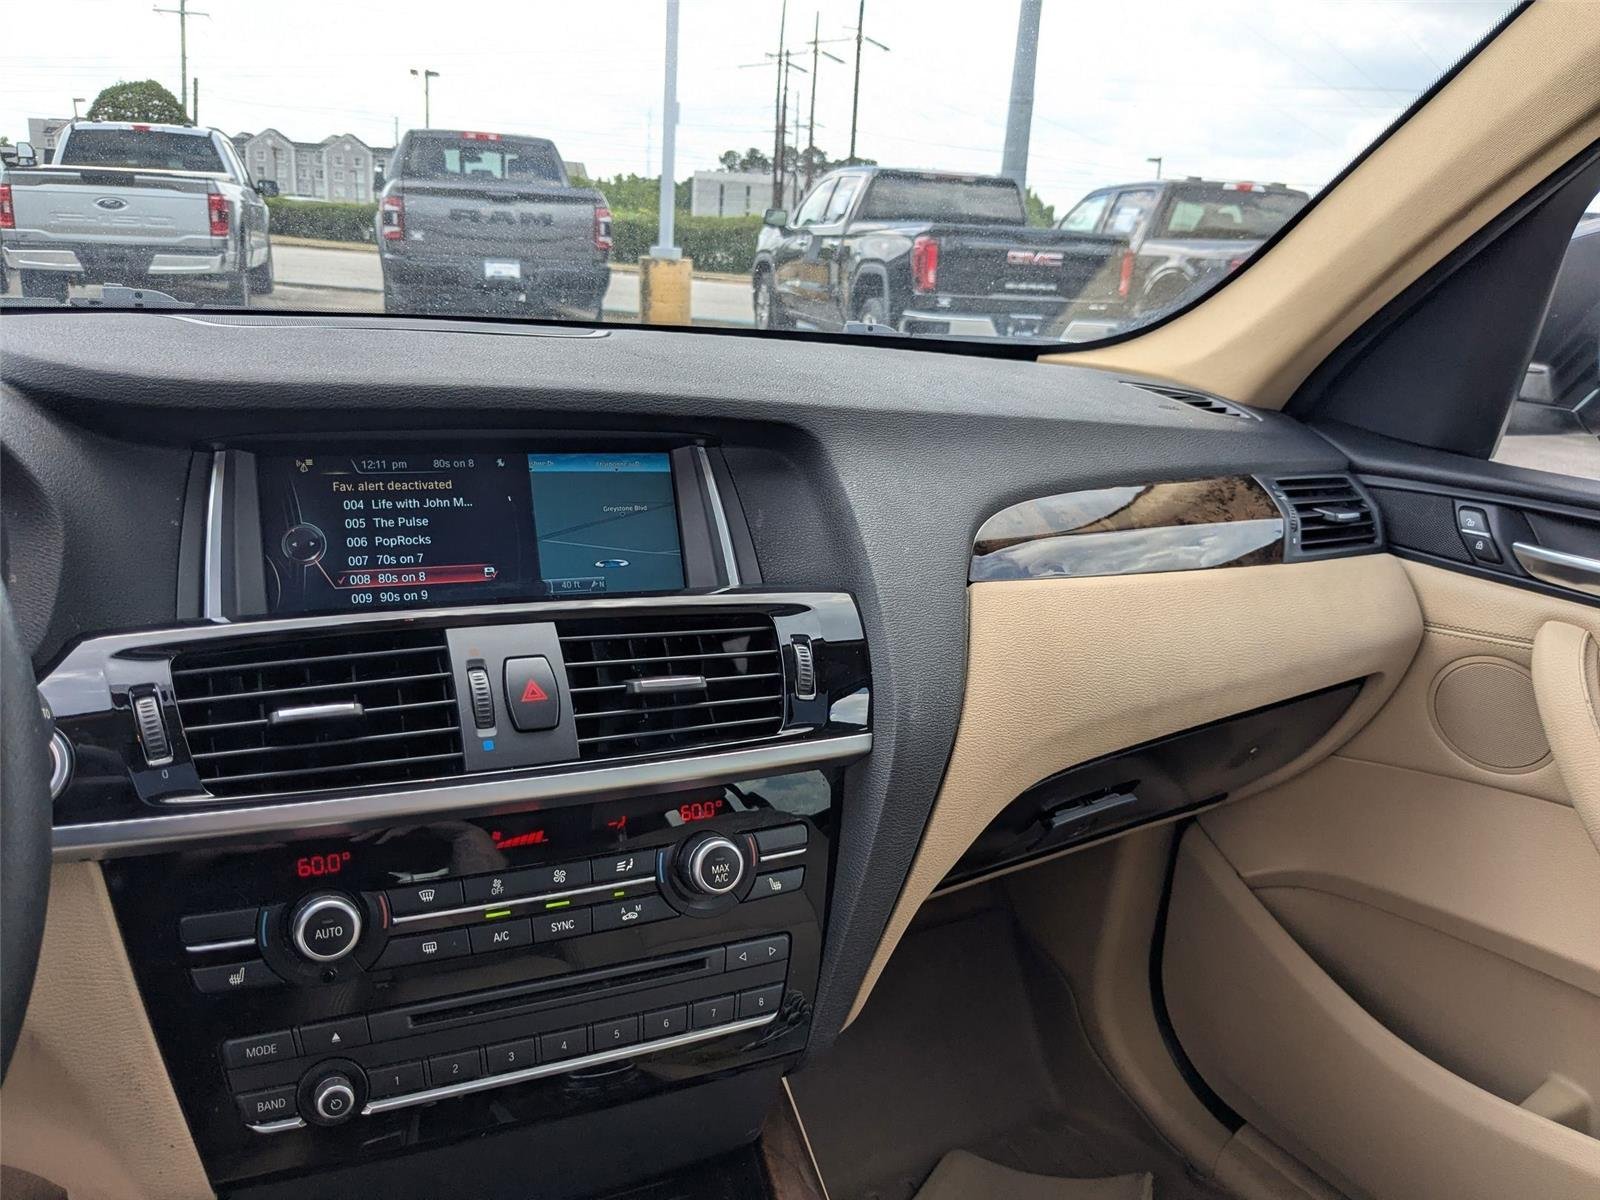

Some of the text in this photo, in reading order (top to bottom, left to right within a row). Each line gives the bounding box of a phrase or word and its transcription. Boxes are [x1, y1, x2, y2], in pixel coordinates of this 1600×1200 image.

[450, 208, 554, 227] RAM
[1007, 250, 1065, 268] GMC
[360, 459, 408, 471] 12:11 pm
[433, 458, 475, 469] 80s on 8
[332, 479, 453, 493] Fav. alert deactivated
[343, 497, 473, 511] 004 Life with John M...
[602, 504, 648, 513] Greystone Blvd
[345, 516, 429, 529] 005 The Pulse
[346, 534, 432, 549] 006 PopRocks
[348, 553, 424, 566] 007 70s on 7
[350, 572, 426, 585] 008 80s on 8
[561, 580, 581, 589] 40 ft
[351, 590, 428, 604] 009 90s on 9
[711, 863, 730, 875] MAX
[714, 873, 729, 884] A/C
[491, 885, 505, 896] OFF
[635, 904, 642, 912] M
[551, 919, 575, 933] SYNC
[314, 926, 344, 940] AUTO
[493, 930, 510, 943] A/C
[758, 997, 765, 1007] 8
[711, 1008, 717, 1018] 7
[663, 1018, 670, 1028] 6
[614, 1029, 620, 1039] 5
[245, 1043, 278, 1058] MODE
[561, 1040, 568, 1050] 4
[508, 1051, 515, 1062] 3
[452, 1064, 459, 1074] 2
[394, 1075, 400, 1085] 1
[257, 1098, 287, 1113] BAND
